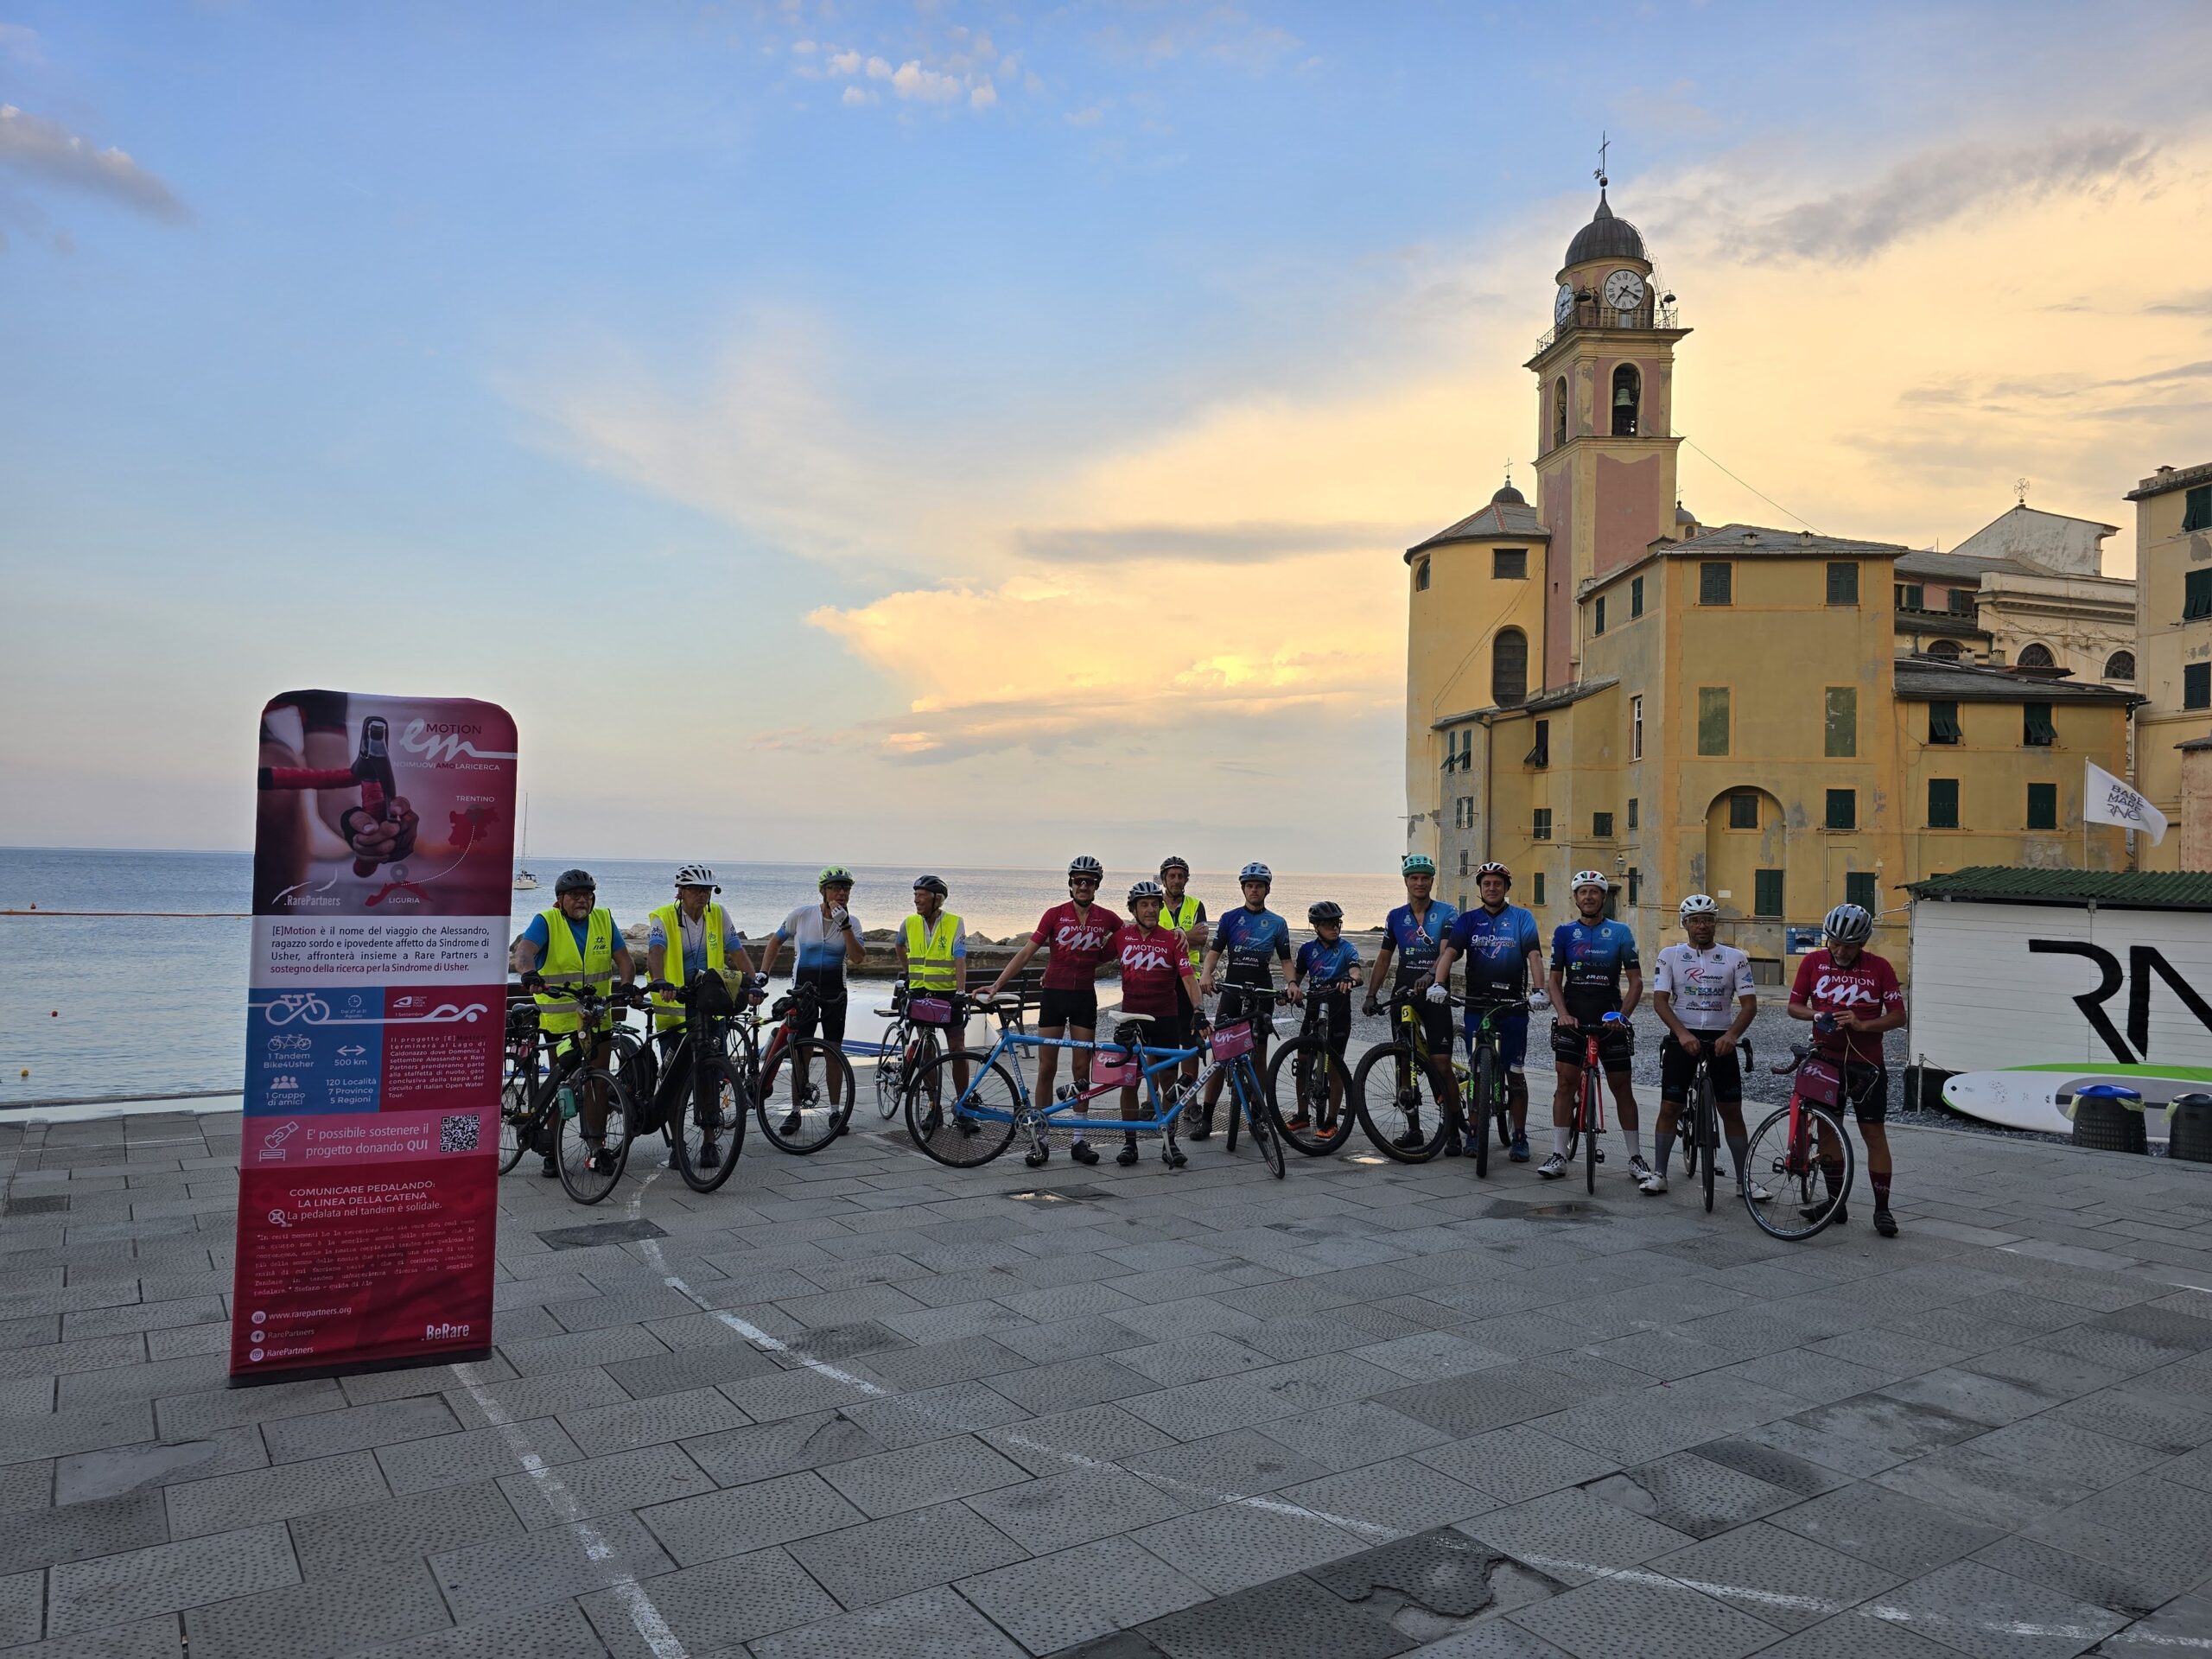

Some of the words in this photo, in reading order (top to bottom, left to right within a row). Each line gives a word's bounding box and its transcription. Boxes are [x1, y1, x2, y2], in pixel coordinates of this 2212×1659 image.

[426, 724, 481, 734] MOTION
[2111, 785, 2144, 807] BASE
[272, 925, 315, 937] [E]Motion
[320, 926, 326, 935] è
[330, 925, 334, 935] il
[368, 926, 382, 935] del
[385, 926, 418, 938] viaggio
[422, 926, 437, 935] che
[441, 926, 490, 936] Alessandro,
[271, 941, 307, 950] ragazzo
[308, 939, 334, 948] sordo
[344, 939, 393, 950] ipovedente
[395, 938, 424, 948] affetto
[439, 938, 480, 947] Sindrome
[480, 938, 489, 947] di
[1133, 944, 1167, 954] MOTION
[271, 951, 301, 961] Usher,
[307, 951, 354, 960] affronterà
[360, 951, 397, 960] insieme
[270, 965, 311, 975] sostegno
[313, 964, 334, 973] della
[336, 964, 365, 973] ricerca
[366, 965, 380, 974] per
[382, 963, 390, 972] la
[391, 963, 432, 972] Sindrome
[434, 963, 442, 971] di
[443, 963, 469, 971] Usher.
[1831, 976, 1875, 987] MOTION
[264, 1061, 315, 1070] Bike4Usher
[343, 1077, 378, 1086] Località
[268, 1098, 276, 1107] di
[278, 1097, 303, 1106] amici
[271, 1092, 306, 1102] Gruppo
[338, 1095, 372, 1105] Regioni
[307, 1128, 315, 1140] E'
[319, 1127, 365, 1141] possibile
[369, 1125, 420, 1137] sostenere
[423, 1122, 429, 1135] il
[306, 1144, 352, 1159] progetto
[355, 1141, 404, 1154] donando
[407, 1139, 429, 1152] QUI
[289, 1185, 364, 1198] COMUNICARE
[298, 1199, 311, 1208] LA
[314, 1198, 346, 1207] LINEA
[349, 1195, 382, 1205] DELLA
[385, 1192, 427, 1202] CATENA
[287, 1211, 297, 1220] La
[301, 1209, 341, 1222] pedalata
[344, 1207, 358, 1217] nel
[360, 1205, 395, 1215] tandem
[397, 1204, 404, 1212] è
[406, 1200, 442, 1211] solidale.
[269, 1307, 353, 1319] www.rarepartners.org
[267, 1329, 315, 1339] RarePartners
[266, 1347, 314, 1357] RarePartners
